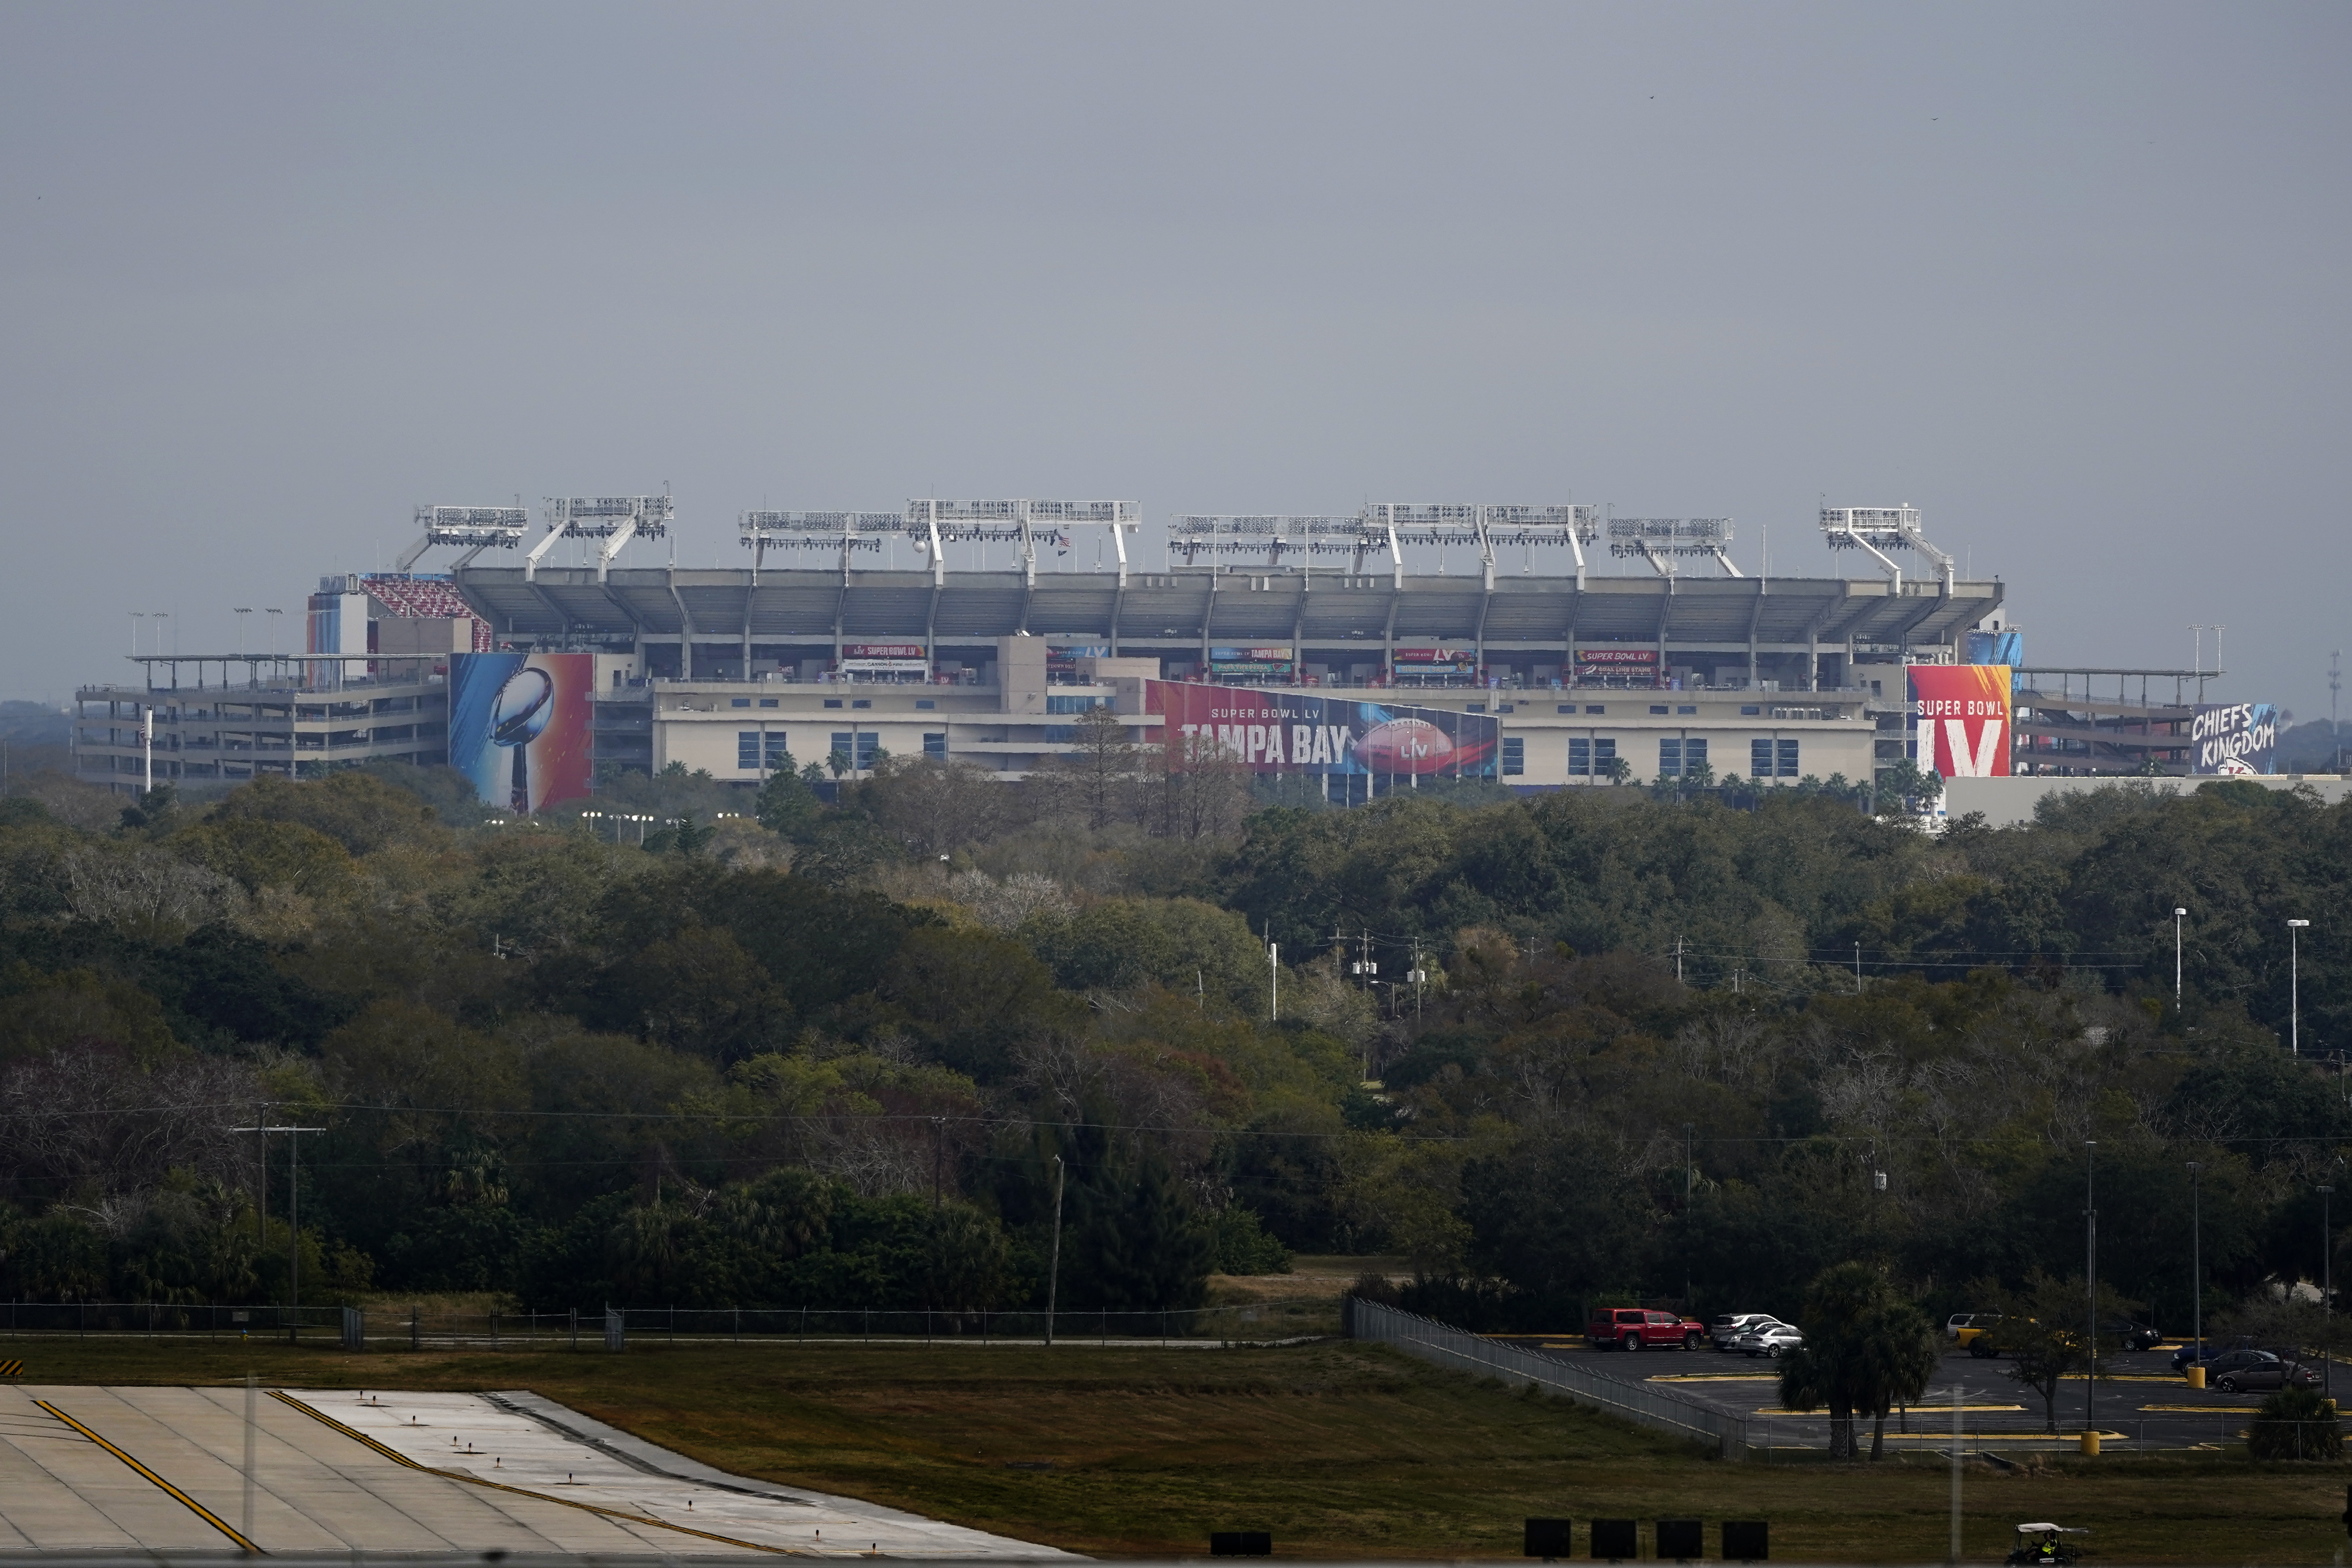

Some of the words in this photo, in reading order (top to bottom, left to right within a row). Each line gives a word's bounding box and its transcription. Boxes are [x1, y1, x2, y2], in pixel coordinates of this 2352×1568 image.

[868, 647, 888, 655] SUPER
[889, 647, 907, 655] BOWL
[1085, 647, 1107, 657] LV
[1251, 649, 1272, 658] TAMPA
[1273, 650, 1285, 658] BAY
[1433, 649, 1455, 661] LV
[1212, 709, 1254, 718] SUPER
[1262, 709, 1298, 719] BOWL
[1305, 709, 1319, 719] LV
[1917, 700, 1961, 716] SUPER
[1968, 700, 2003, 716] BOWL
[2192, 703, 2252, 741] CHIEFS
[1180, 724, 1285, 764] TAMPA
[1292, 724, 1349, 764] BAY
[2201, 723, 2274, 768] KINGDOM
